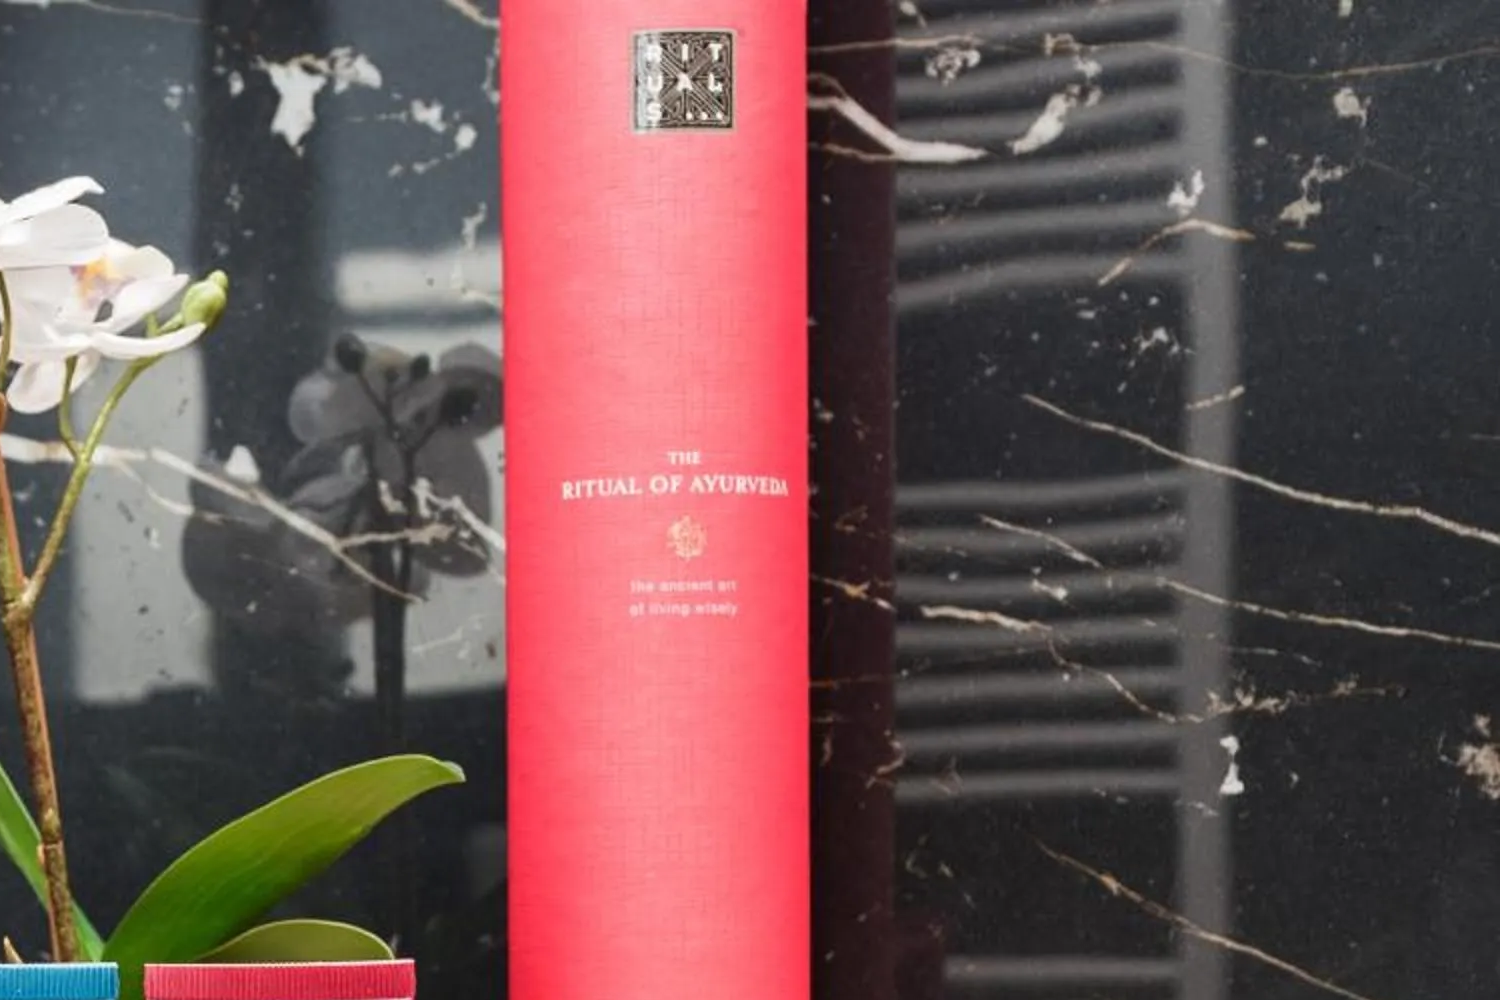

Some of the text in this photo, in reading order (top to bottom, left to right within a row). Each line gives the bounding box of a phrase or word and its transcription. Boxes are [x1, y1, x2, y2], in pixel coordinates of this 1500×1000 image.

[667, 451, 702, 466] THE
[562, 474, 789, 501] RITUAL OF AYURVEDA
